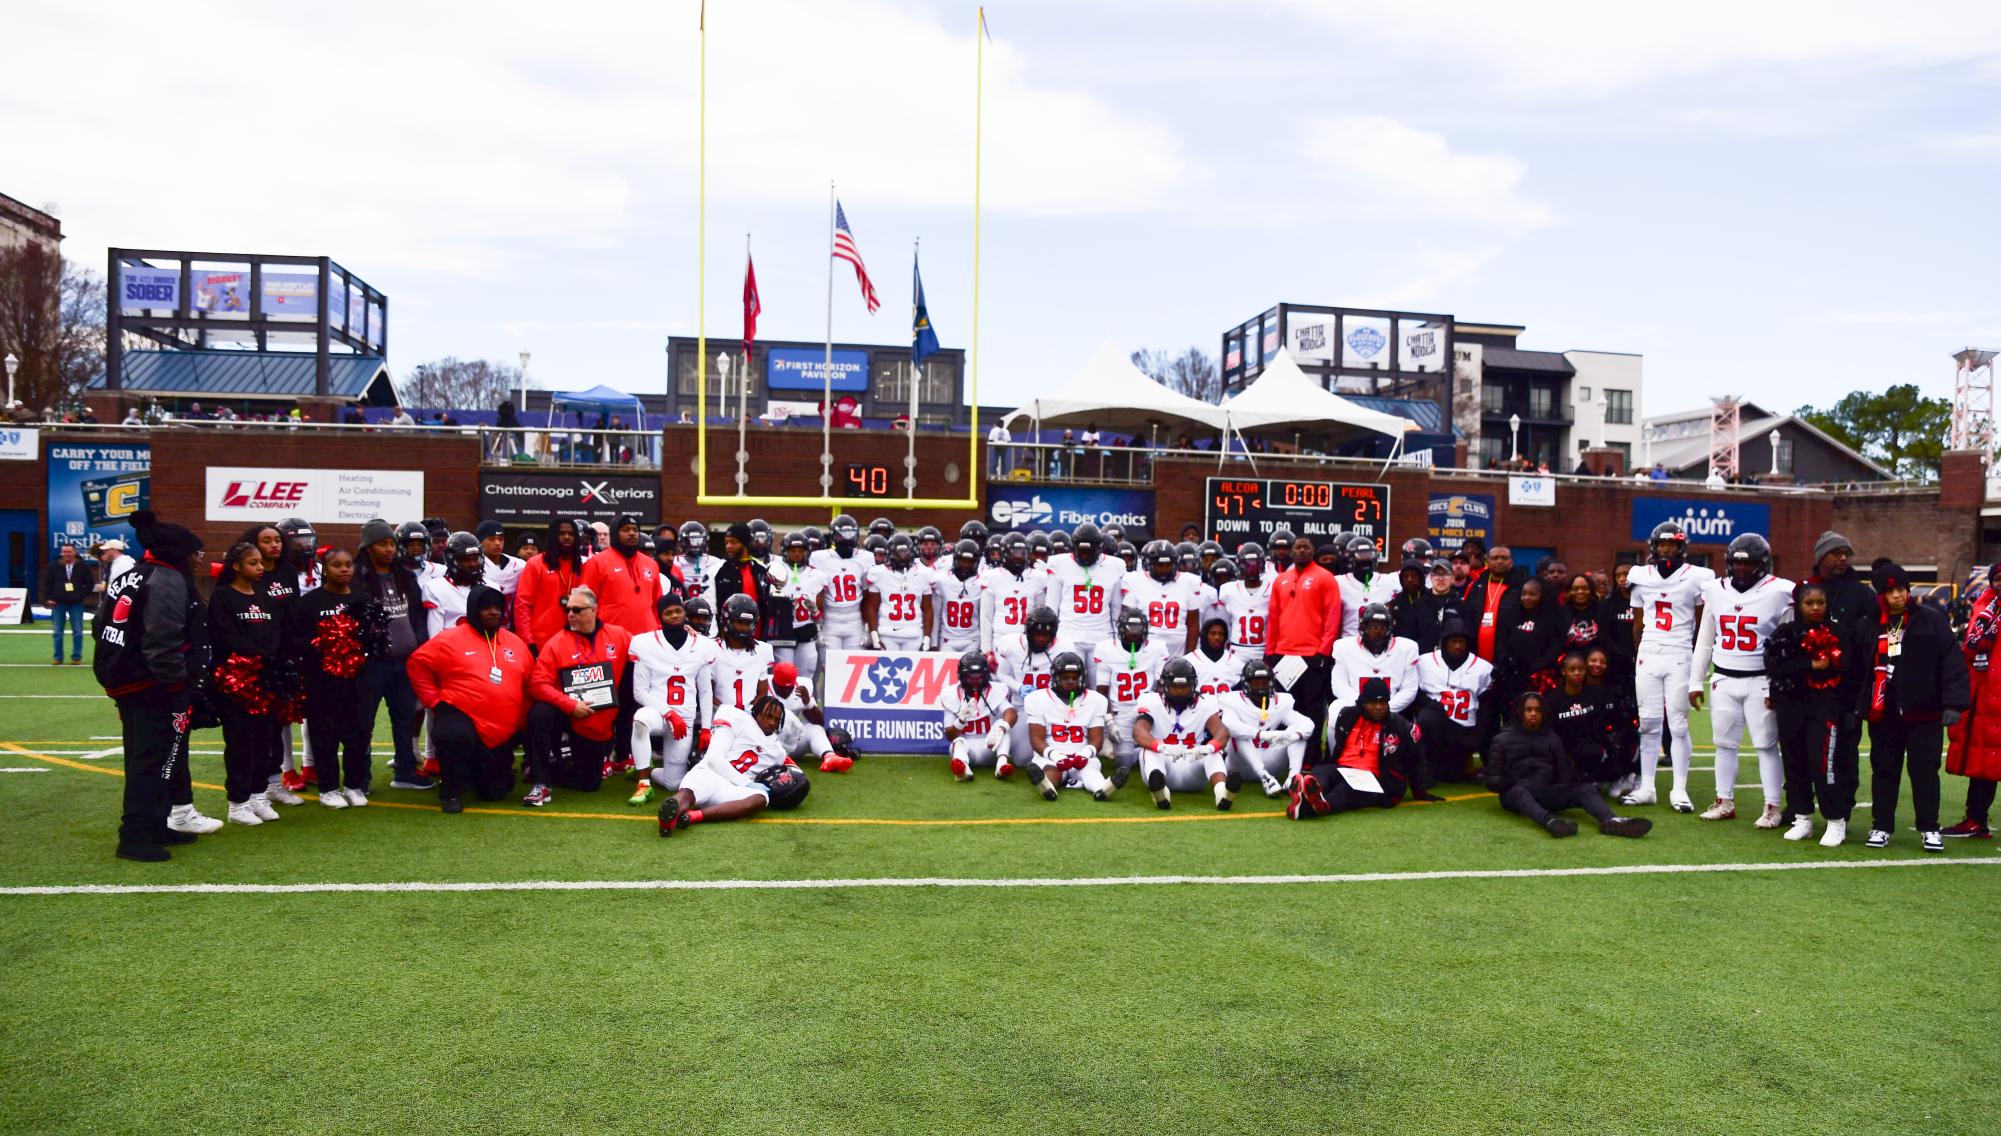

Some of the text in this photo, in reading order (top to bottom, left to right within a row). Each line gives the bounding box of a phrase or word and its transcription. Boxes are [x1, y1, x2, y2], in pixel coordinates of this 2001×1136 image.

[127, 283, 174, 301] SOBER
[1295, 325, 1324, 340] CHATTA
[1406, 332, 1435, 347] CHATTA
[1300, 337, 1326, 351] NOOGA
[1411, 343, 1436, 358] NOOGA
[785, 361, 812, 370] FIRST
[801, 371, 847, 380] PAVION
[52, 448, 96, 459] CARRY
[100, 449, 134, 460] YOUR
[69, 461, 91, 471] OFF
[94, 461, 119, 471] THE
[339, 474, 374, 483] Heating
[850, 467, 887, 494] 40
[253, 481, 308, 501] LEE
[339, 486, 412, 496] Air Conditioning
[485, 484, 574, 497] Chattanooga
[1221, 482, 1259, 493] ALCOA
[1285, 483, 1329, 506] 0:00
[1341, 487, 1376, 499] PEARL
[249, 501, 300, 510] COMPANY
[339, 499, 382, 508] Plumbing
[992, 495, 1146, 528] epb Fiber Optics
[1216, 495, 1244, 515] 47
[1355, 500, 1381, 521] 27
[339, 511, 379, 519] Electrical
[1445, 518, 1466, 528] JOIN
[1216, 519, 1250, 532] DOWN
[1259, 521, 1274, 533] TO
[1275, 521, 1291, 533] GO
[1304, 522, 1326, 535] BALL
[1328, 523, 1342, 535] ON
[1465, 529, 1486, 538] CLUB
[53, 532, 130, 549] FirstBk
[1376, 537, 1384, 551] 2
[833, 575, 857, 602] 16
[888, 594, 916, 621] 33
[1074, 585, 1105, 614] 58
[946, 601, 974, 629] 88
[1004, 597, 1027, 625] 31
[1149, 601, 1180, 629] 60
[1655, 601, 1673, 632] 5
[1239, 616, 1264, 645] 19
[1719, 615, 1758, 651] 55
[667, 675, 686, 706] 6
[733, 678, 745, 711] 1
[1116, 671, 1147, 702] 22
[876, 720, 943, 740] RUNNERS
[729, 750, 759, 774] 0
